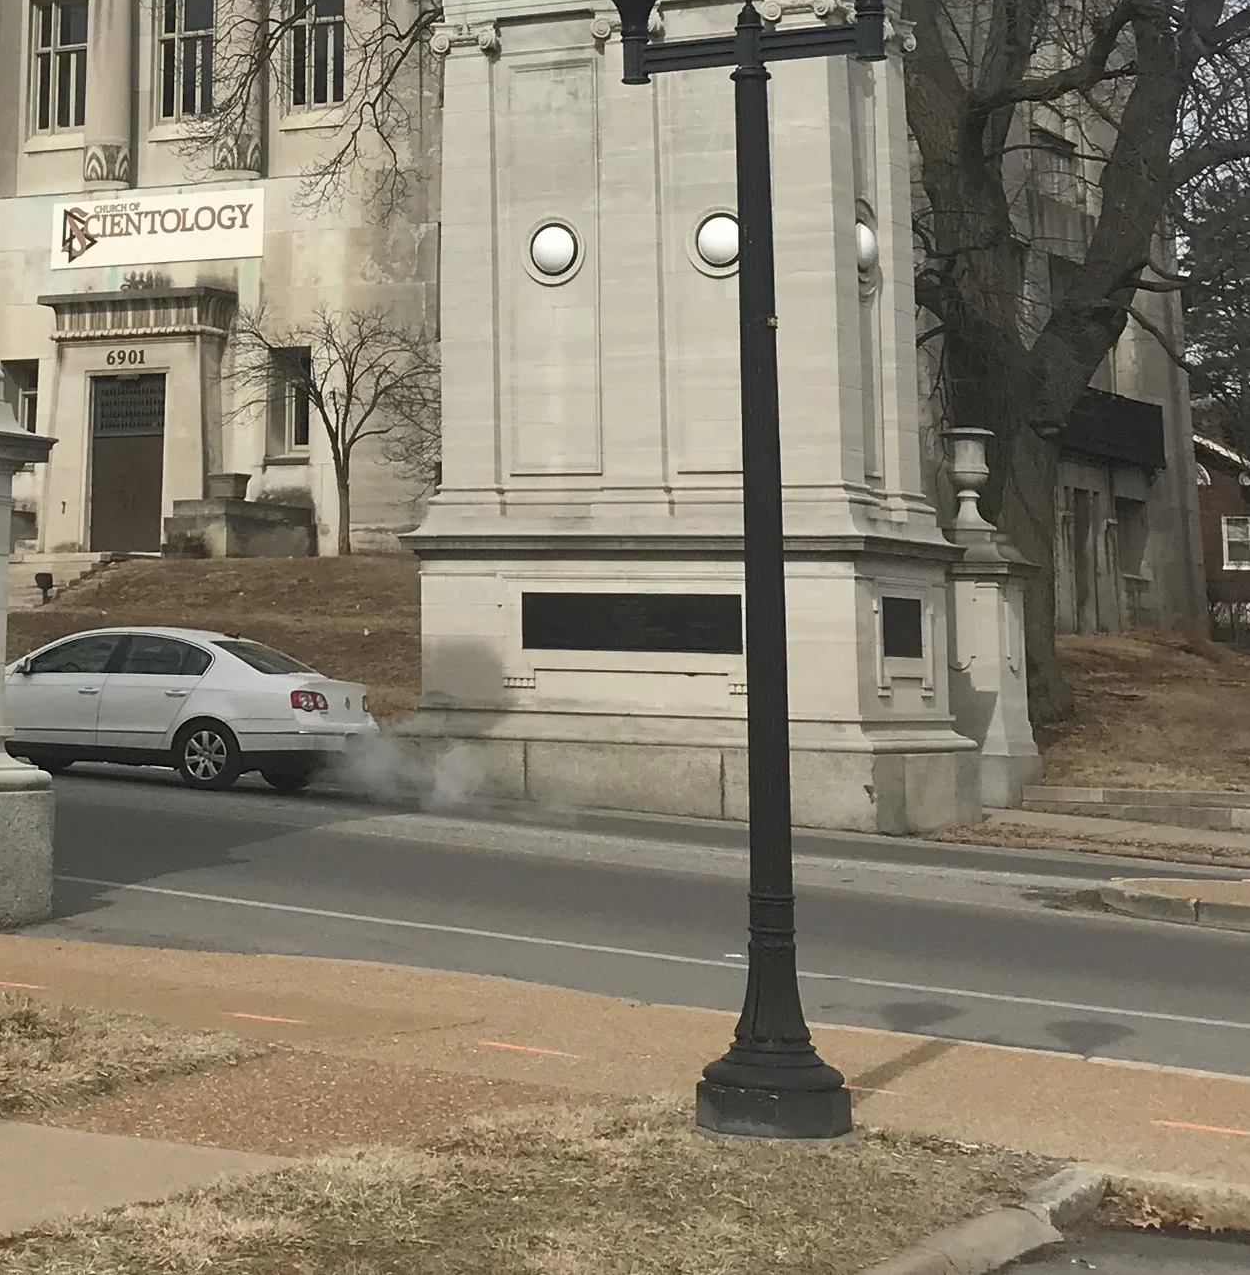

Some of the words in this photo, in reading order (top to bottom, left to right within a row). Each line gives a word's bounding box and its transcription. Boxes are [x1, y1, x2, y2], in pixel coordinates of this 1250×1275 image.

[94, 205, 127, 213] CHURCH
[129, 203, 141, 212] OF
[61, 204, 253, 257] SCIENTOLOGY
[106, 350, 145, 365] 6901
